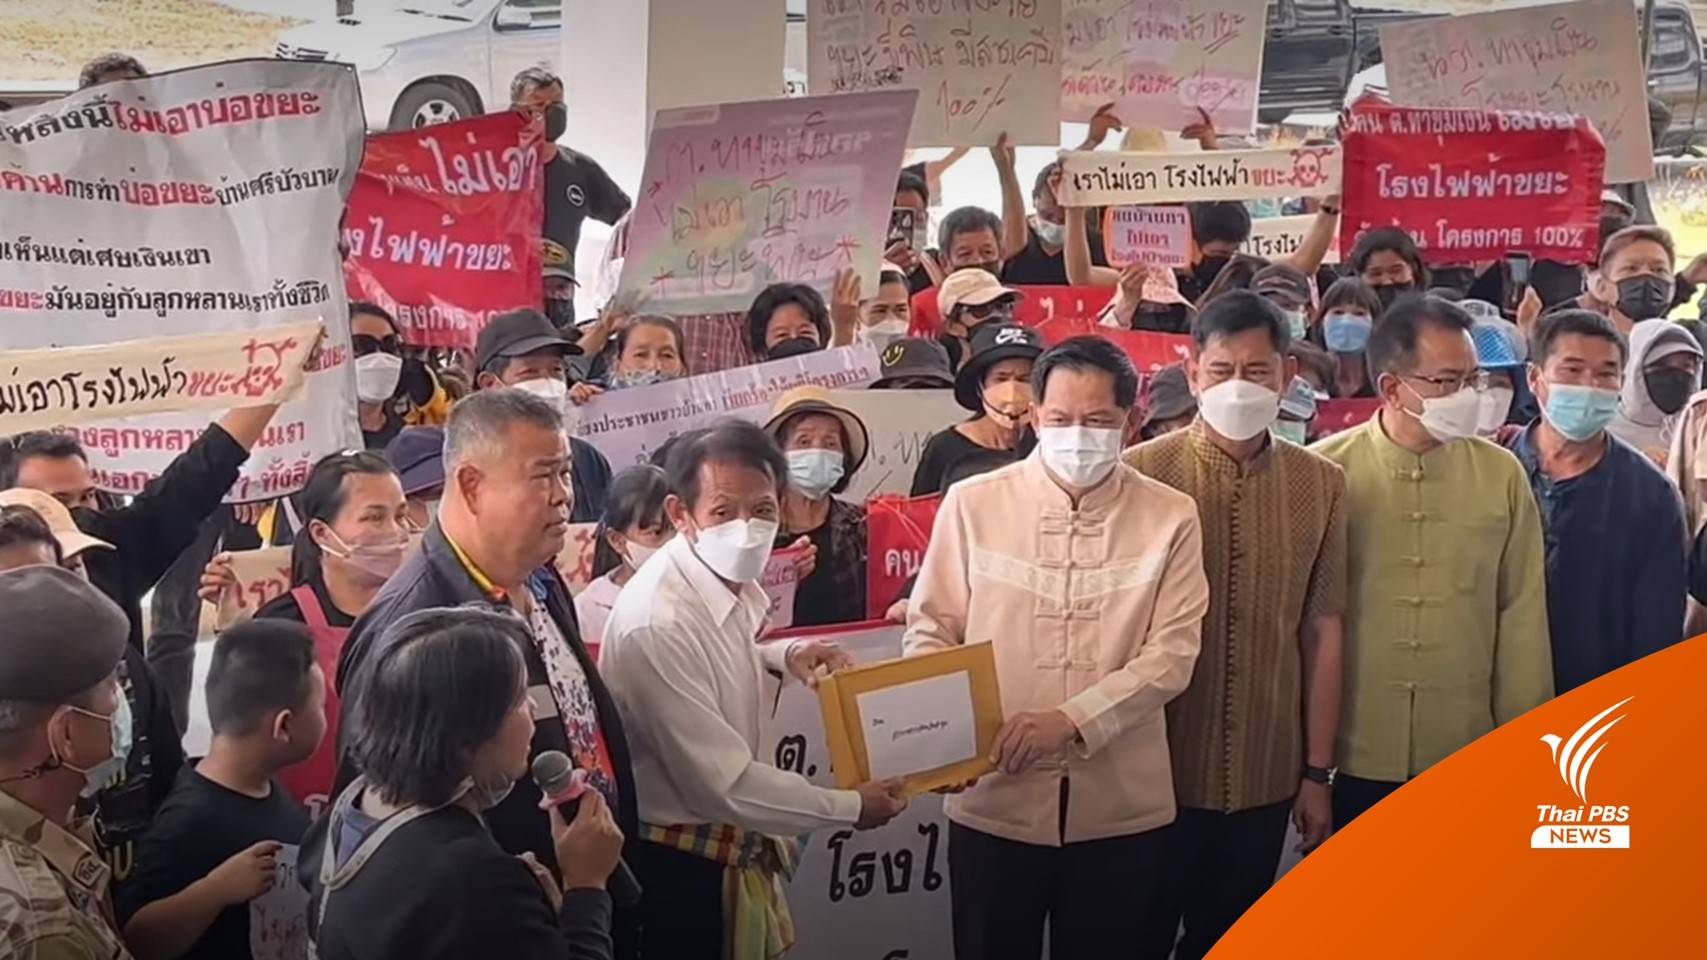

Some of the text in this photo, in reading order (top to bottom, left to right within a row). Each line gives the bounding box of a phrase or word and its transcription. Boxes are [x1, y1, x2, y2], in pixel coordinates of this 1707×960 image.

[418, 131, 538, 196] ไม่เอา
[1073, 162, 1157, 191] เราไม่เอา
[1376, 154, 1570, 199] โรงไฟฟ้าขยะ
[1437, 219, 1523, 248] โครงการ
[1534, 226, 1584, 247] 100%
[0, 235, 212, 269] เห็นแต่เศษเงินเขา
